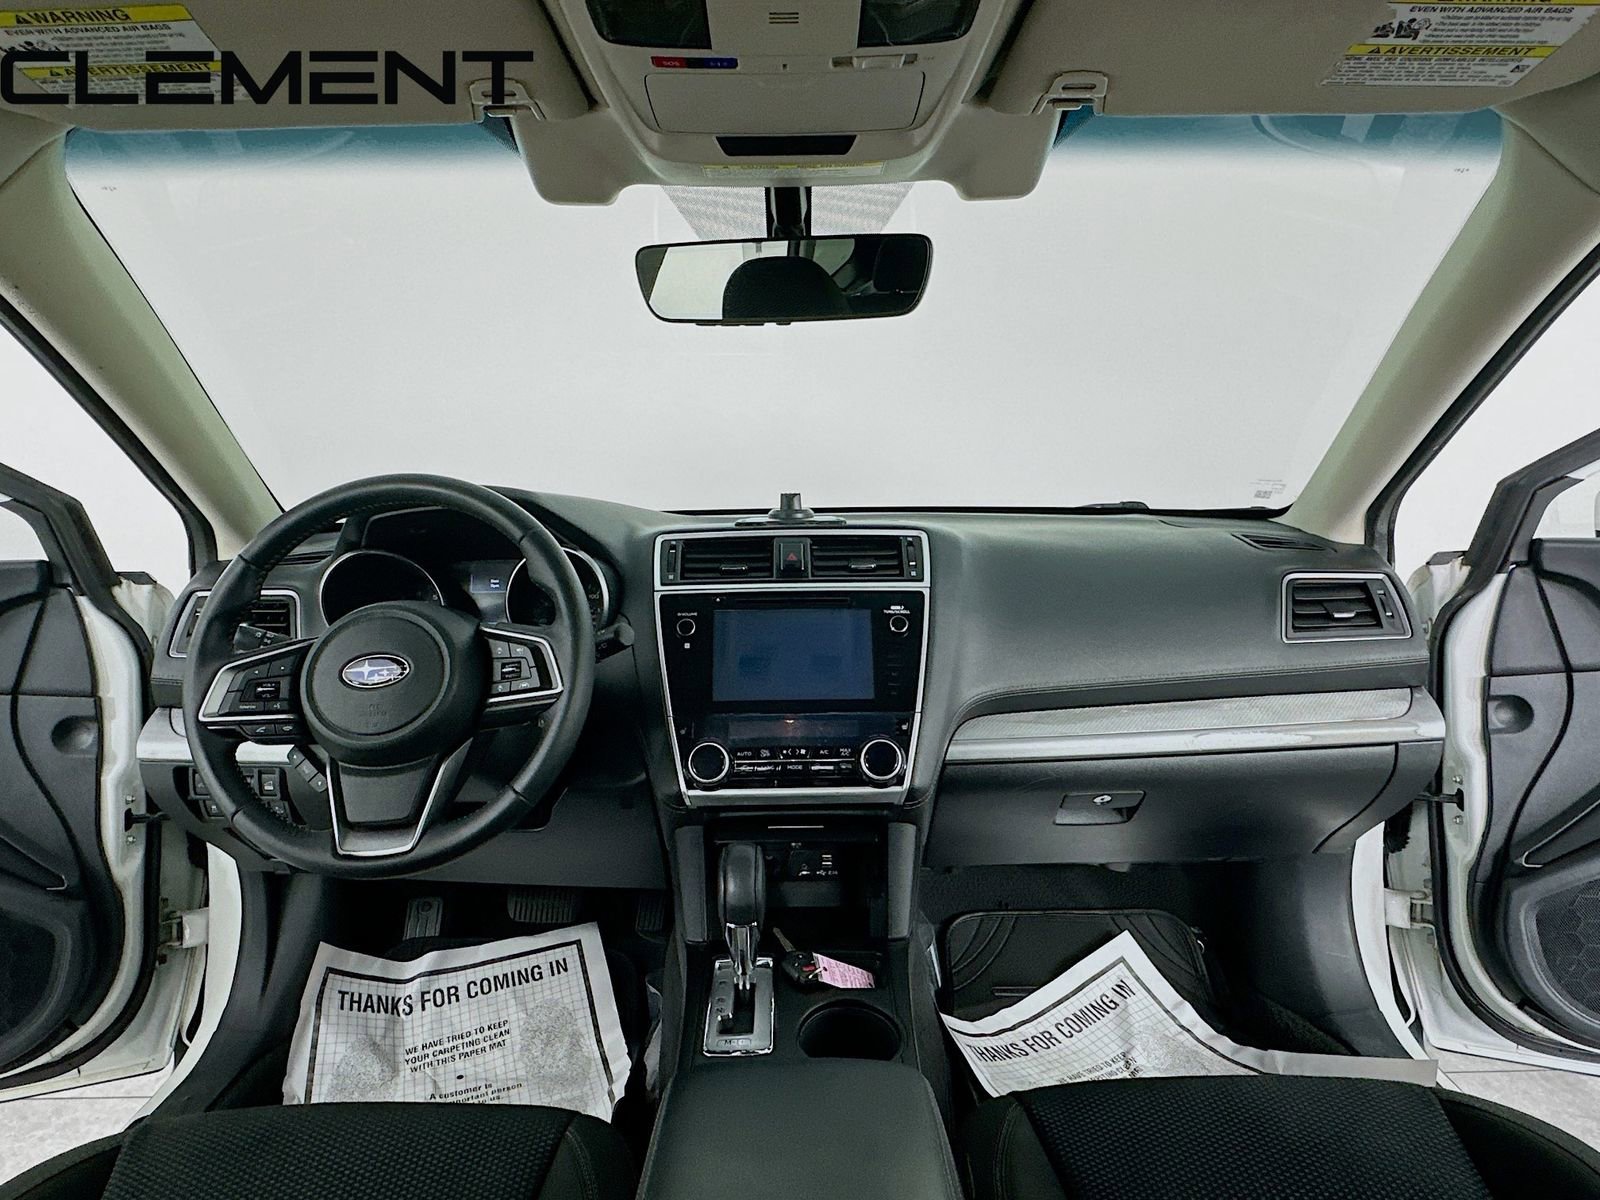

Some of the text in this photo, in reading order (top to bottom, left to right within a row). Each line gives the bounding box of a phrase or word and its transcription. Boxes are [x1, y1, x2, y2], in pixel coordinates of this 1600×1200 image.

[28, 9, 131, 25] WARNING
[1466, 6, 1523, 14] ADVANCED
[64, 26, 120, 35] ADVANCED
[1384, 46, 1538, 56] AVERTISSEMENT
[65, 62, 212, 77] AERTISSEMENT
[337, 957, 569, 1017] THANKS FOR COMING IN
[967, 979, 1136, 1063] THANKS FOR COMING IN
[404, 1019, 509, 1056] WE HAVE TRIED TO KEEP
[404, 1028, 510, 1065] YOUR CARPETING CLEAN
[409, 1038, 507, 1073] WITH THIS PAPER MAT
[429, 1093, 437, 1101] A
[438, 1084, 482, 1099] customer
